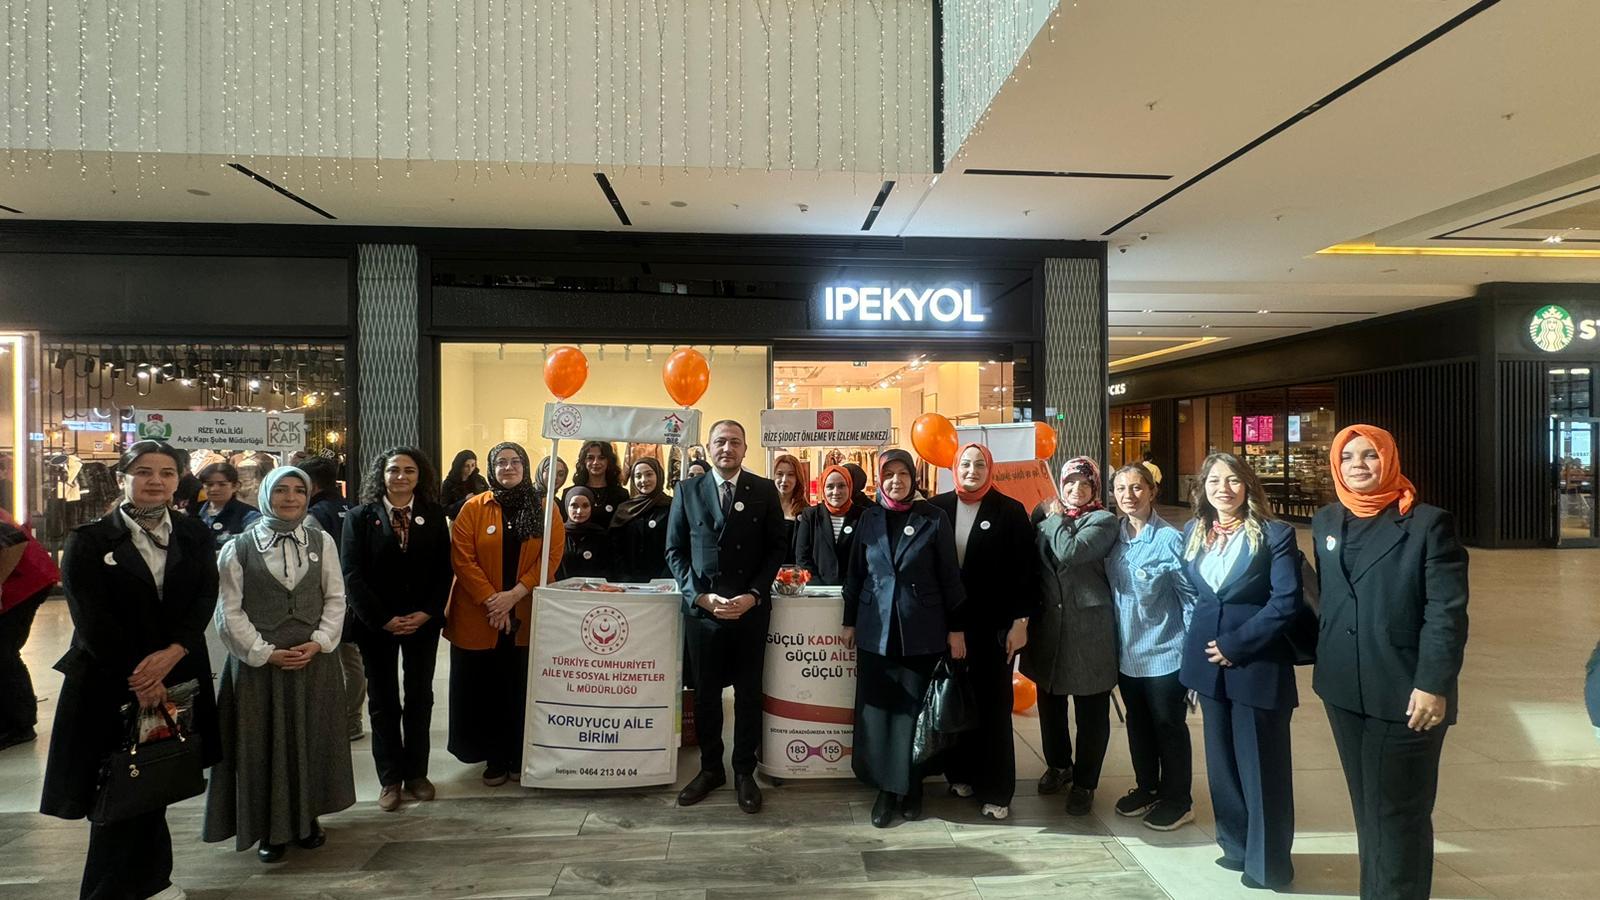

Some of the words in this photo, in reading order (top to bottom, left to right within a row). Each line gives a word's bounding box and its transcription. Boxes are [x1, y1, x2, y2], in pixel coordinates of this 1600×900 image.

[825, 286, 985, 322] IPEKYOL
[215, 427, 243, 435] VALİLİĞİ
[763, 431, 777, 441] RİZE
[778, 430, 801, 444] ŞİDDET
[801, 430, 827, 442] ÖNLEME
[828, 431, 836, 441] VE
[837, 429, 860, 441] İZLEME
[861, 429, 889, 441] MERKEZİ
[210, 436, 227, 445] Şube
[270, 433, 300, 444] KAPI
[766, 632, 804, 648] GÜÇLÜ
[808, 635, 846, 646] KADIN
[552, 656, 590, 668] TÜRKİYE
[591, 659, 656, 670] CUMHURİYETİ
[785, 649, 827, 664] GÜÇLÜ
[542, 667, 561, 678] AİLE
[563, 669, 574, 679] VE
[576, 670, 610, 681] SOSYAL
[612, 671, 665, 682] HİZMETLER
[801, 665, 843, 680] GÜÇLÜ
[566, 682, 575, 692] İL
[576, 683, 638, 695] MÜDÜRLÜĞÜ
[547, 714, 620, 729] KORUYUCU
[623, 716, 654, 729] AİLE
[578, 730, 620, 744] BİRİMİ
[790, 745, 806, 754] 183
[823, 745, 840, 754] 155
[579, 767, 598, 776] 0464
[600, 768, 614, 777] 213
[616, 768, 626, 777] 04
[628, 768, 638, 776] 04
